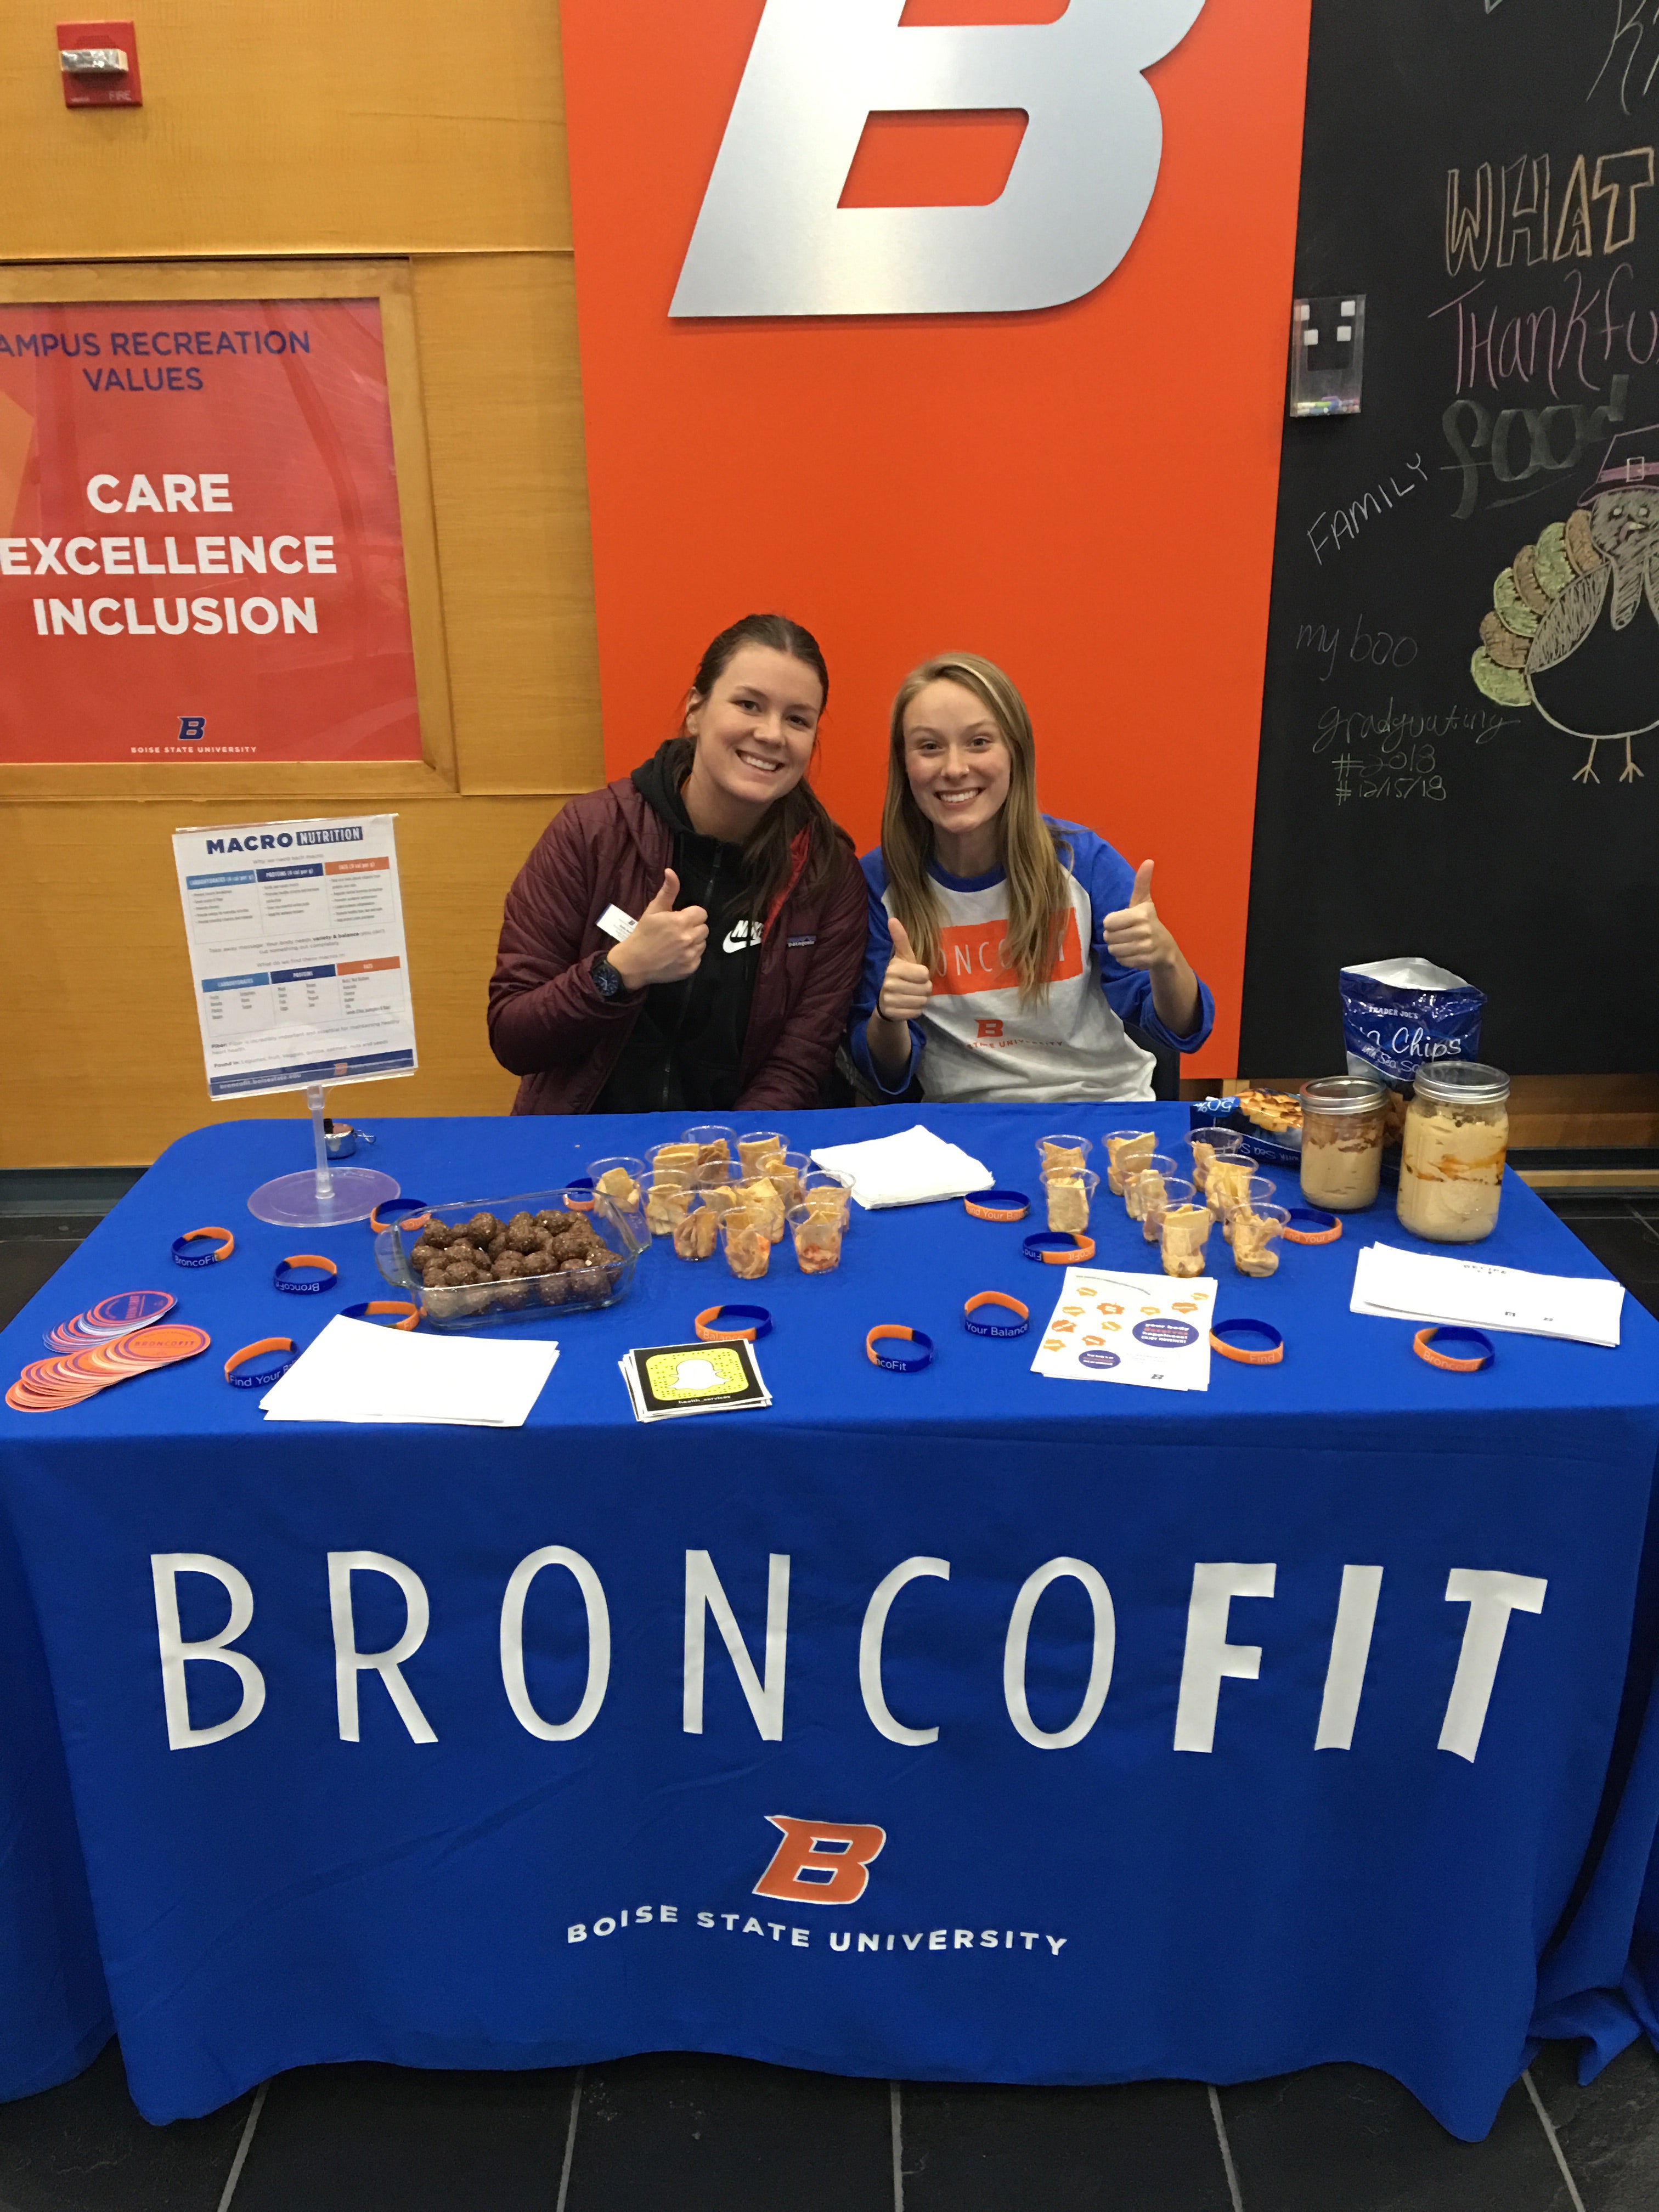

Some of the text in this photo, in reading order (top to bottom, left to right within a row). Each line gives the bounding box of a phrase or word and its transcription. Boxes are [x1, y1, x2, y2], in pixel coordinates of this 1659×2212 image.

[668, 0, 1207, 317] B
[1446, 146, 1654, 276] WHAT
[0, 330, 311, 358] AMPUS RECREATION
[83, 367, 204, 392] VALUES
[87, 473, 233, 514] CARE
[1306, 453, 1427, 565] FAMILY
[0, 535, 337, 575] EXCELLENCE
[33, 597, 319, 636] INCLUSION
[1296, 614, 1418, 681] my boo
[177, 716, 206, 741] B
[206, 827, 360, 855] MACRO NUTRITION
[731, 919, 764, 939] NIK
[1369, 1006, 1419, 1019] TRADER JOE'S
[974, 1019, 1003, 1038] B
[1392, 1026, 1462, 1063] Chips
[1401, 1060, 1426, 1074] Sa
[981, 1209, 1003, 1220] Your
[174, 1252, 218, 1267] BroncoFit
[966, 1321, 988, 1335] Your
[1249, 1353, 1275, 1363] Find
[229, 1371, 281, 1387] Find Your
[150, 1545, 1548, 1764] BRONCOFIT
[752, 1814, 887, 1905] B
[567, 1904, 1068, 1957] BOISE STATE UNIVERSITY
